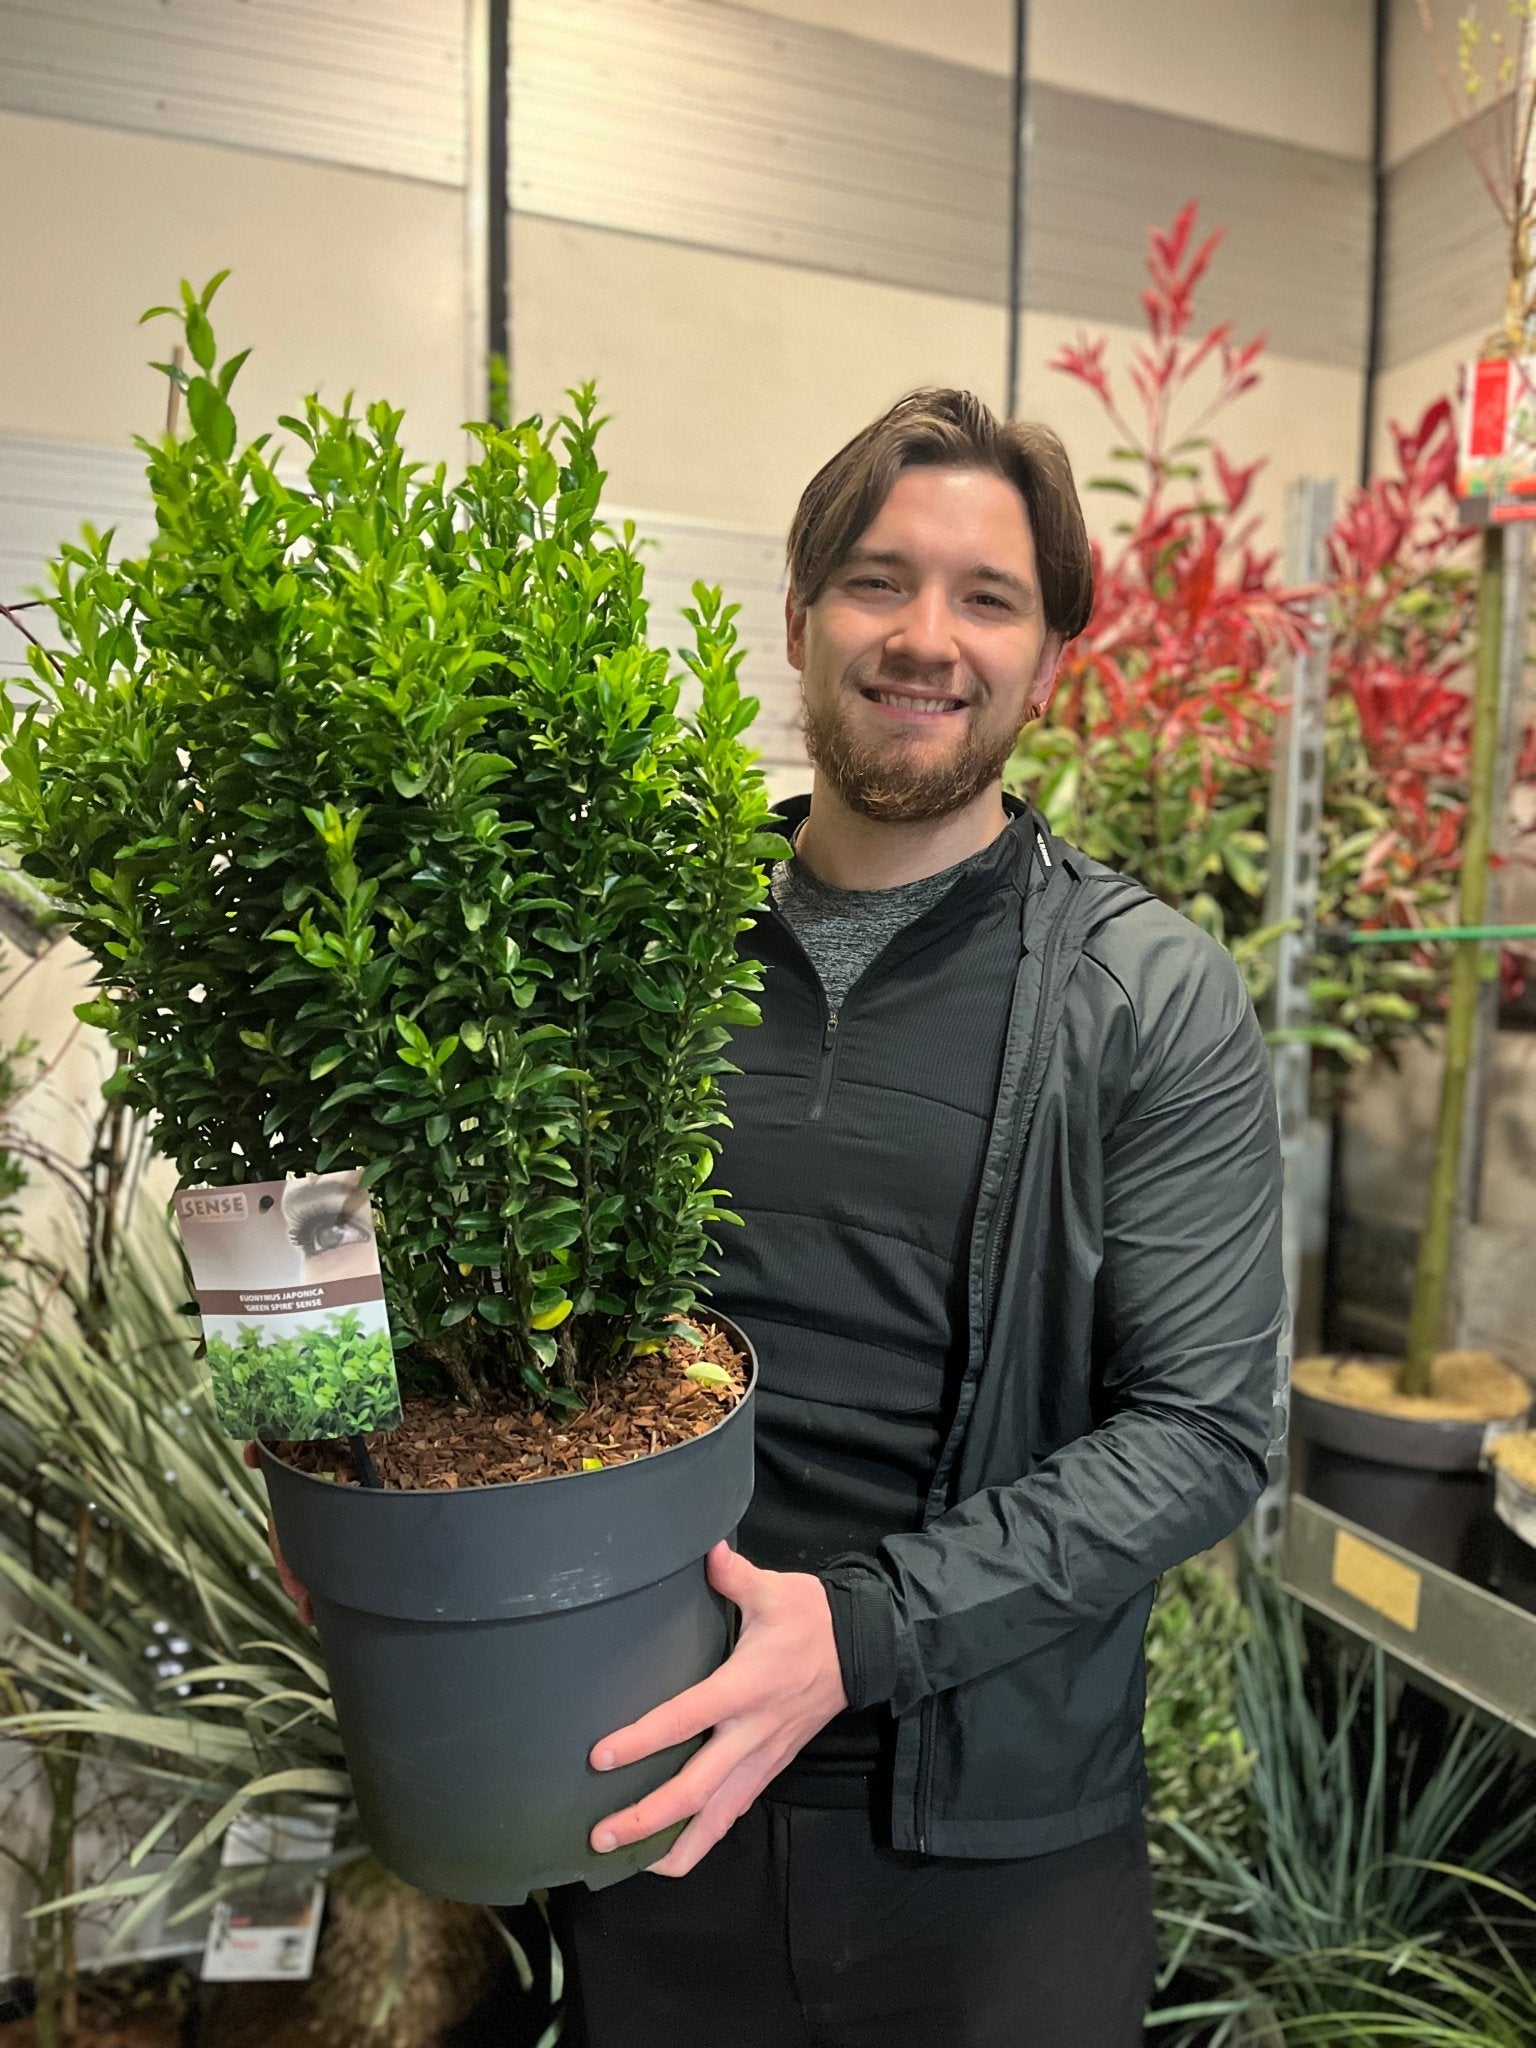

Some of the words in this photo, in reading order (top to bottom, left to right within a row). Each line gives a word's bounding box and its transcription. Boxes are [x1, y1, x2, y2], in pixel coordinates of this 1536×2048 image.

[181, 1196, 244, 1217] SENSE
[239, 1292, 281, 1302] EUONYMUS
[281, 1288, 324, 1301] JAPONICA
[295, 1299, 322, 1309] SENSE
